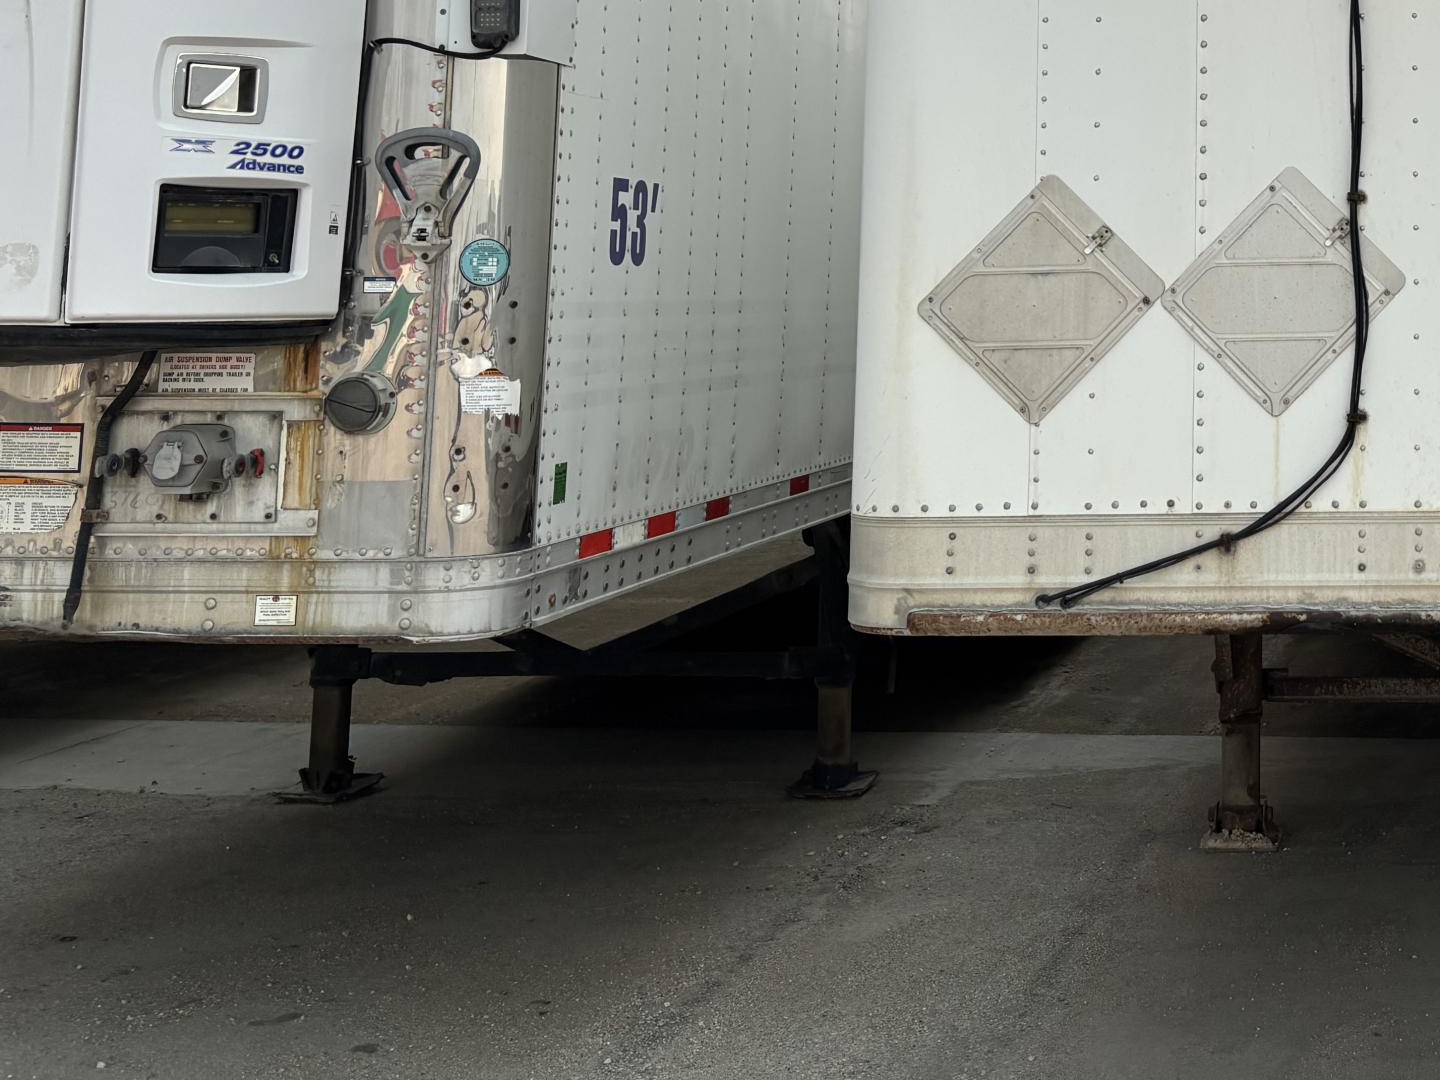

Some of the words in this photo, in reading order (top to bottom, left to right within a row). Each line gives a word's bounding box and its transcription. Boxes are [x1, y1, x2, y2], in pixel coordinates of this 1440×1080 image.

[229, 141, 305, 160] 2500
[226, 157, 305, 175] Advance
[609, 176, 660, 267] 53'
